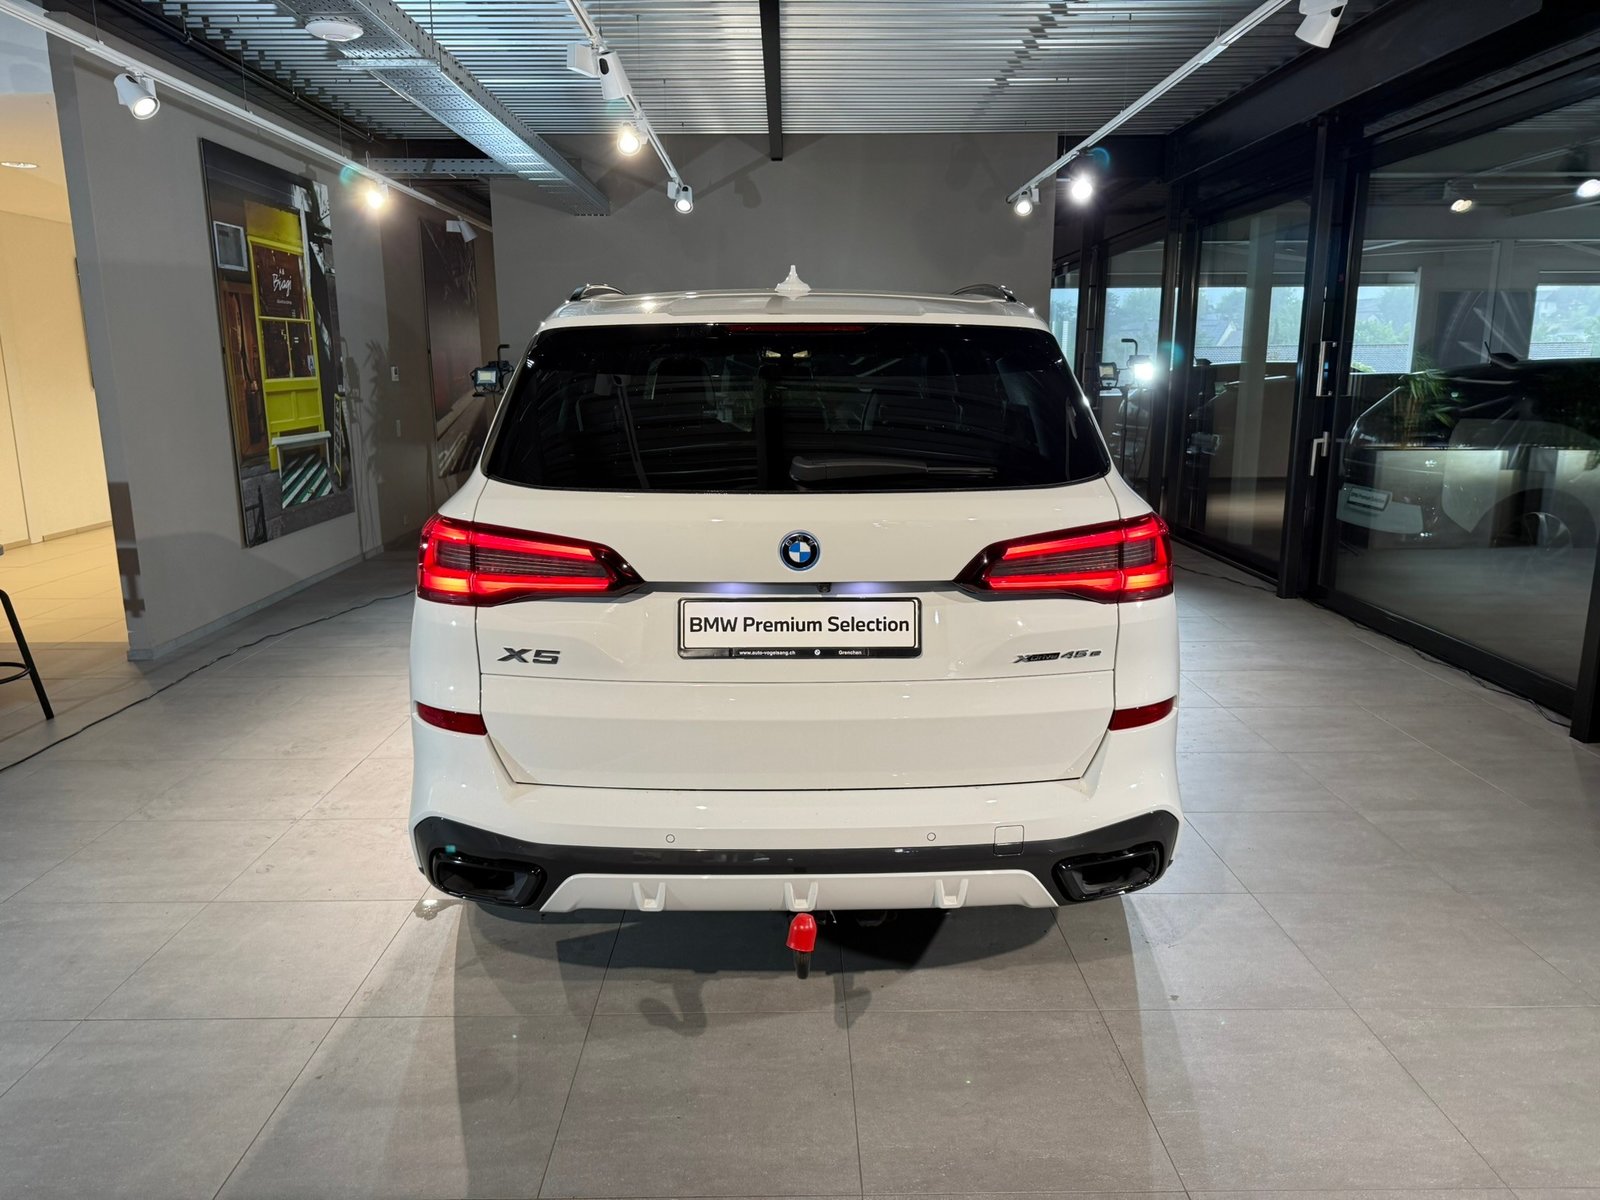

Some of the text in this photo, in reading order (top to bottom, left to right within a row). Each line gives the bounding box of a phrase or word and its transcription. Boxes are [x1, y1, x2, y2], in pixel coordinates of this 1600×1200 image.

[689, 616, 909, 633] BMW Premium Selection
[497, 647, 561, 664] X5
